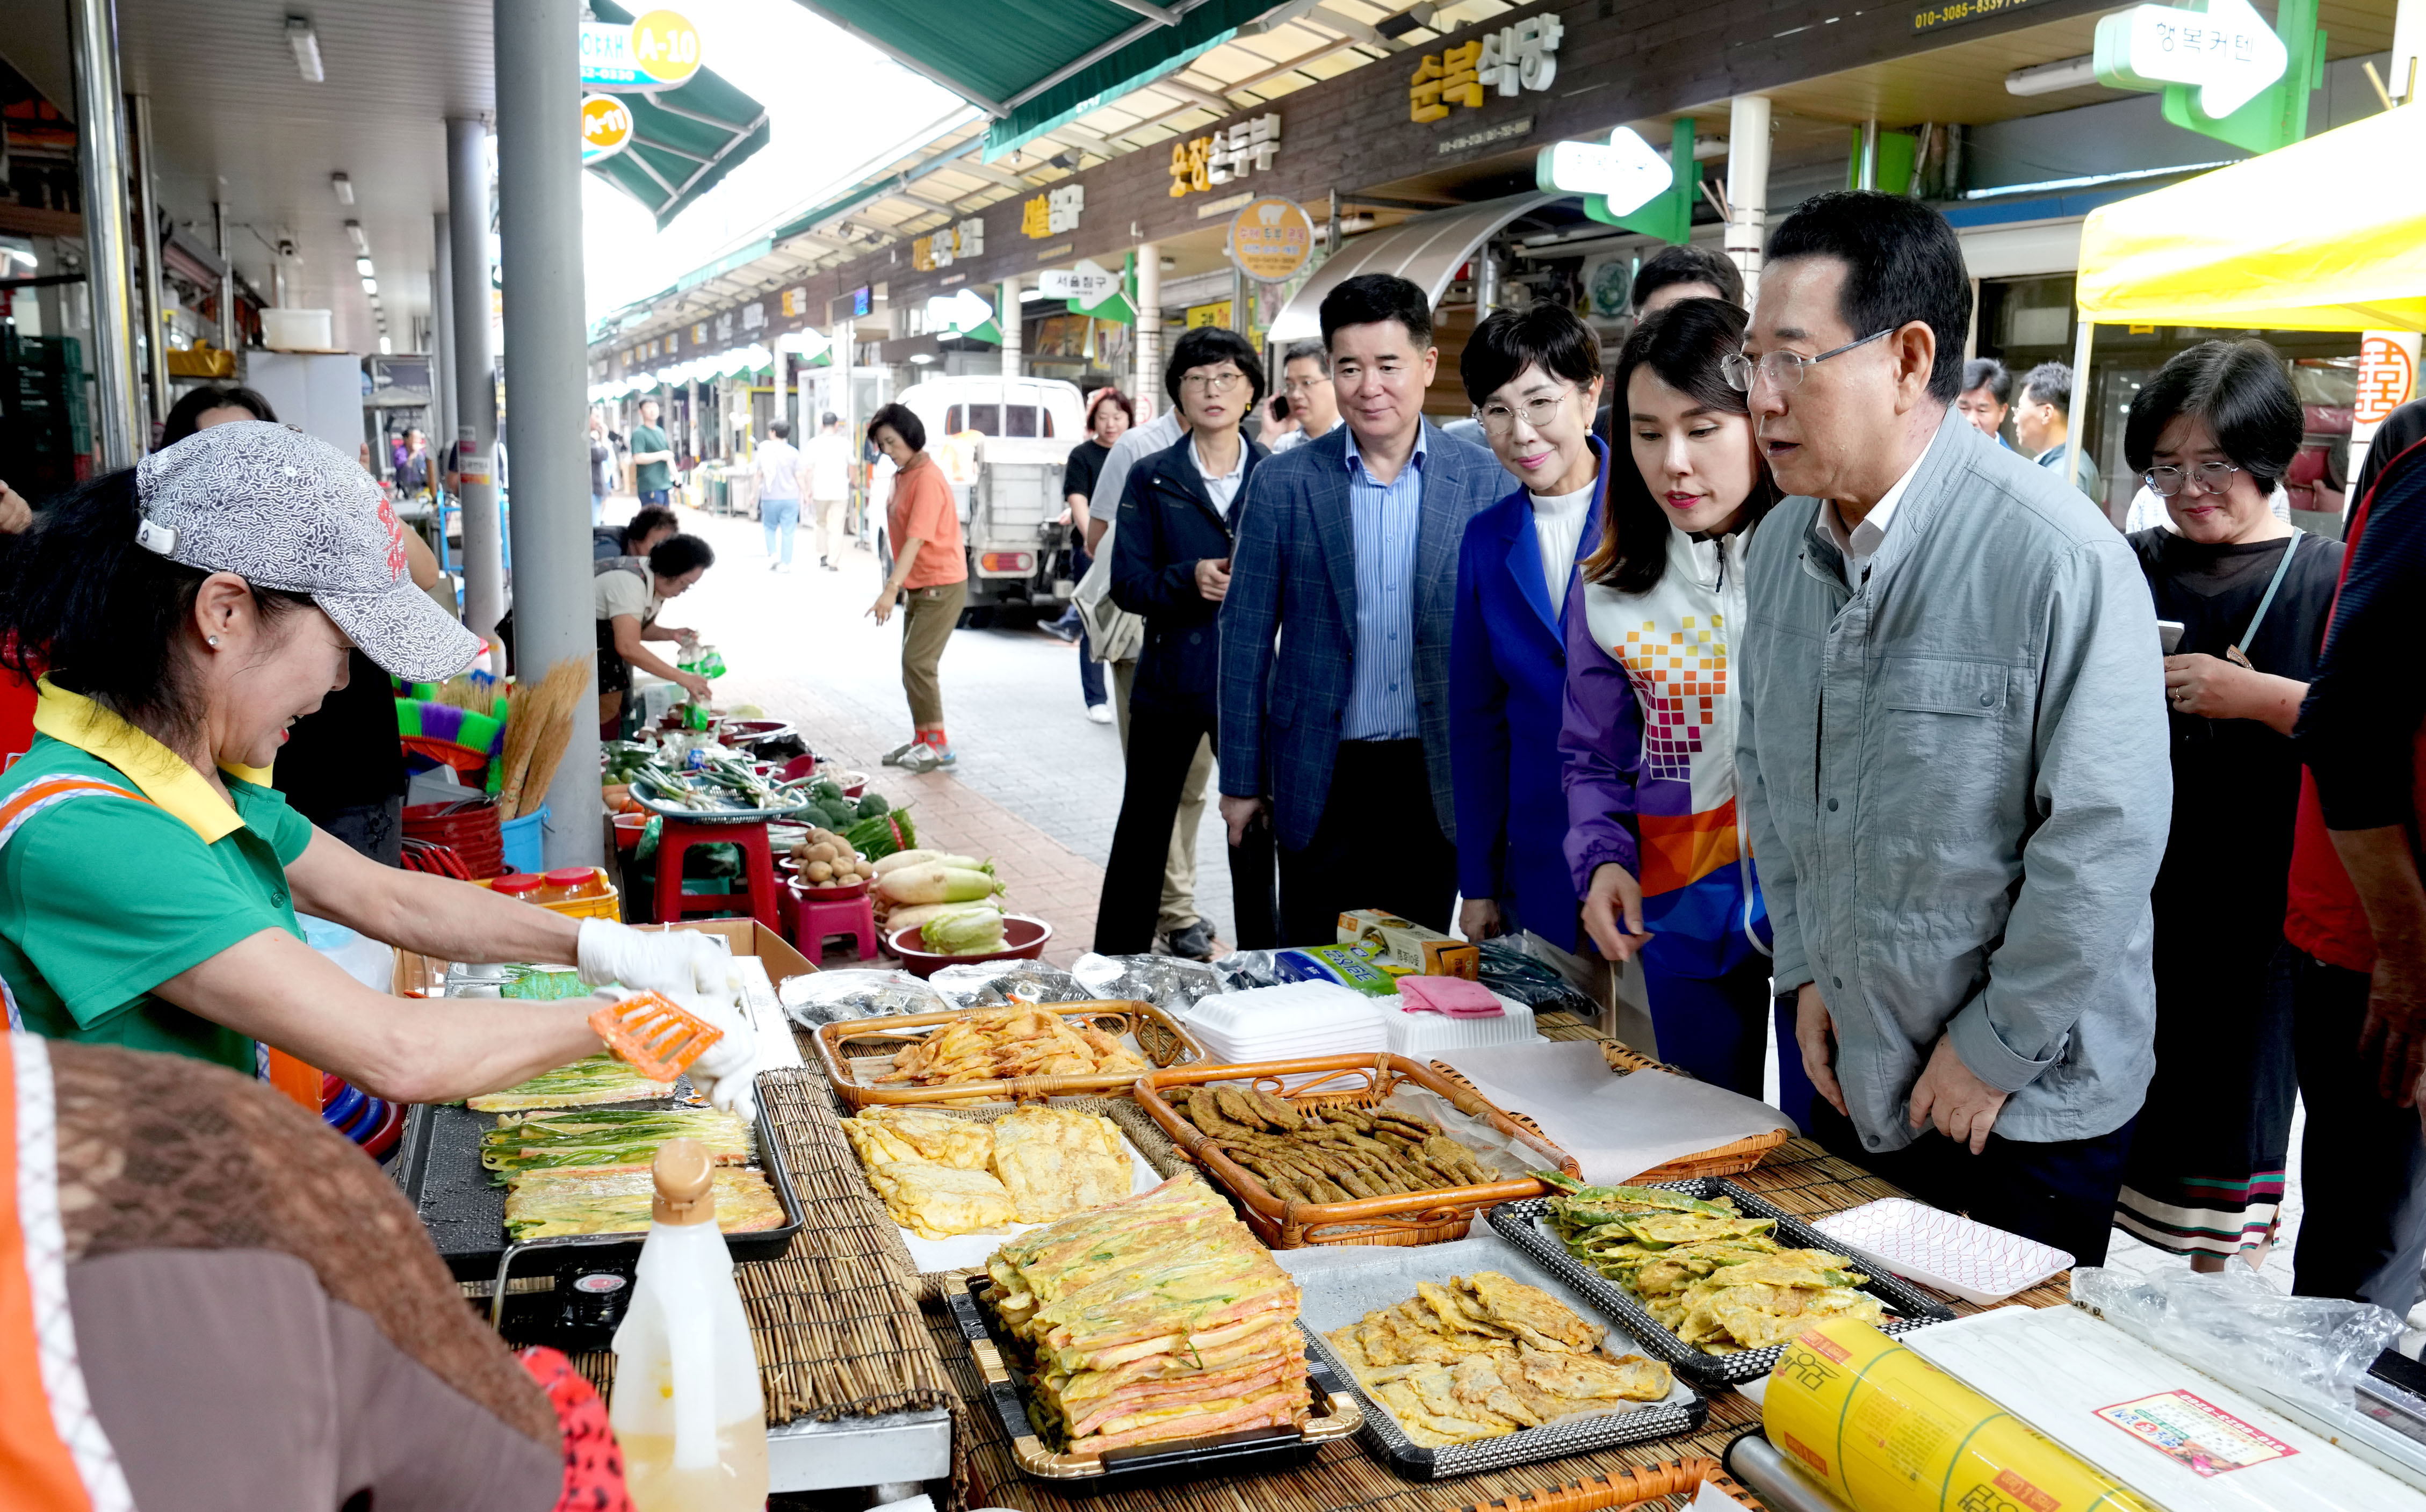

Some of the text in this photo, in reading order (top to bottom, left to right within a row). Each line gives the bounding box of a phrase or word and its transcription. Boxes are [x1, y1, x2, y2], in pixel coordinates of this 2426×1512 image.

[638, 27, 697, 64] A-10
[2156, 22, 2253, 62] 행복커텐
[585, 108, 626, 136] A-11
[1056, 275, 1107, 289] 서울침구
[2179, 1394, 2287, 1451] 010-6623-9260
